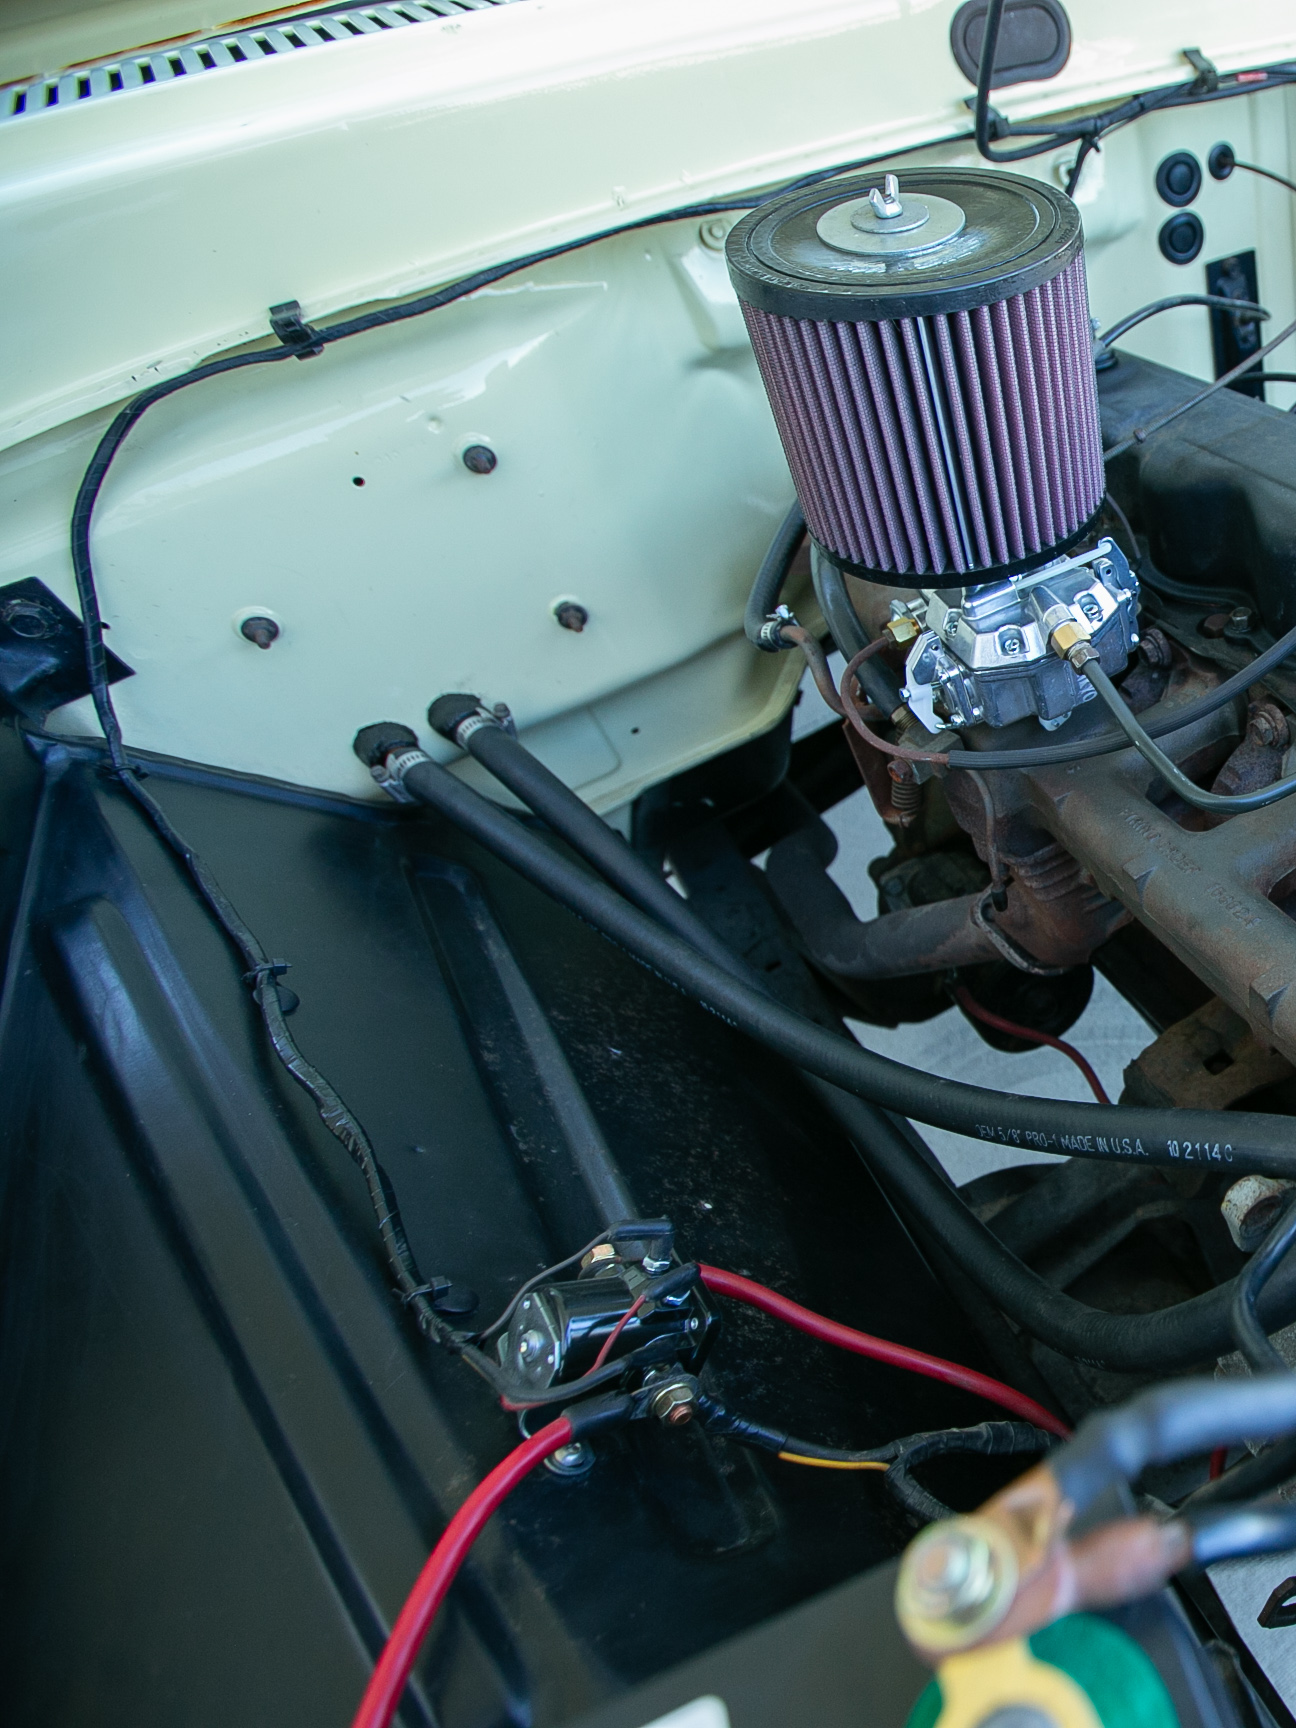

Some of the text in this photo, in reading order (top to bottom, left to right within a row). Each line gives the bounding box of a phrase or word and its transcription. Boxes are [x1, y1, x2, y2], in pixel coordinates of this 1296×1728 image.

[1025, 1130, 1060, 1149] PRO-1
[1060, 1134, 1096, 1152] MADE
[1096, 1136, 1110, 1153] IN
[1110, 1137, 1149, 1156] U.S.A.
